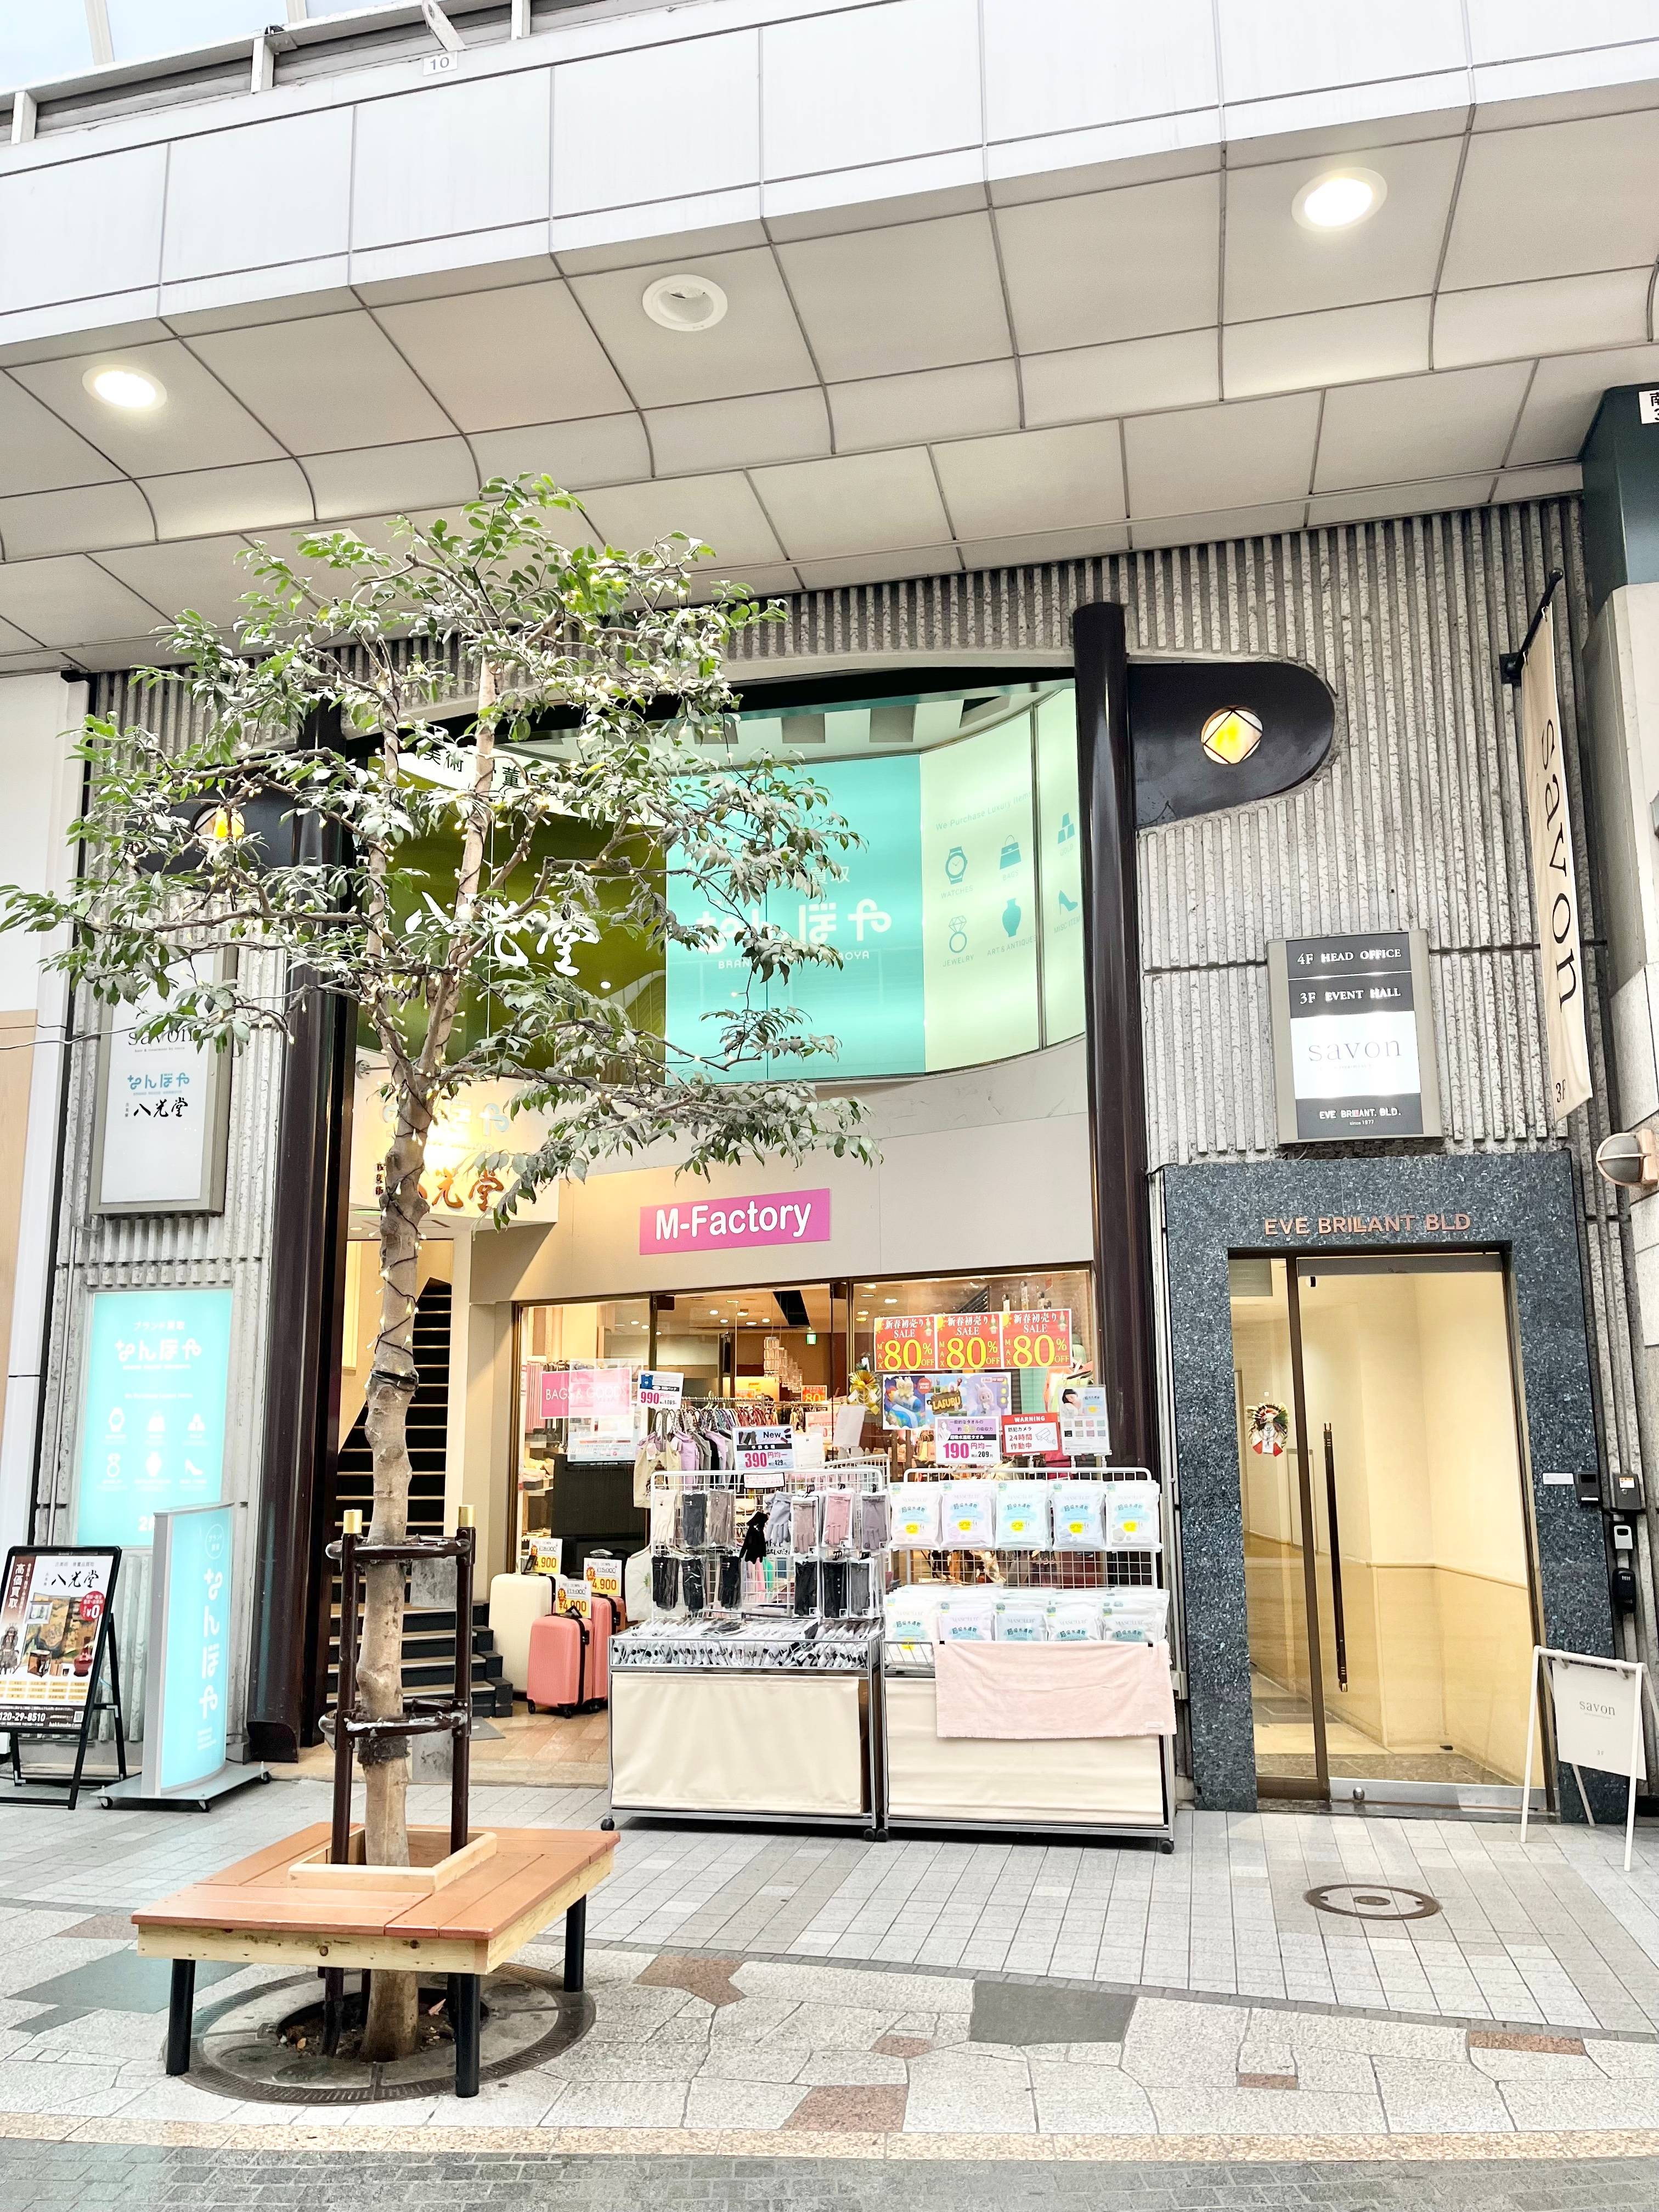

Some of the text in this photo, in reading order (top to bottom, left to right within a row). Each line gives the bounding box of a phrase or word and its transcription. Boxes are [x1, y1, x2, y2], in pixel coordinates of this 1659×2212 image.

[430, 57, 449, 70] 10
[935, 823, 949, 831] We
[950, 810, 986, 828] Purchase
[988, 800, 1012, 815] Luxury
[1542, 718, 1576, 1013] savon
[1002, 870, 1020, 882] BAGS
[940, 885, 974, 900] WATCHES
[988, 947, 1000, 957] ART
[1297, 949, 1402, 965] 4F HEAD OFFICE
[718, 958, 750, 969] BRAN
[942, 955, 974, 968] JEWELRY
[1300, 988, 1401, 1005] 3F EVENT HALL
[1308, 1040, 1402, 1062] savon
[127, 1073, 190, 1090] なんぼや
[1319, 1110, 1336, 1119] EVE
[656, 1200, 812, 1240] M-Factory
[1265, 1217, 1309, 1235] EVE
[1426, 1213, 1470, 1231] BLD
[884, 1318, 924, 1330] 新春初売り
[947, 1315, 988, 1327] 新春初売り
[1014, 1312, 1057, 1324] 新春初売り
[894, 1329, 915, 1339] SALE
[957, 1327, 979, 1335] SALE
[1023, 1324, 1047, 1333] SALE
[115, 1338, 202, 1362] なんぼや
[884, 1339, 922, 1370] 80
[946, 1337, 986, 1369] 80
[1013, 1335, 1055, 1367] 80
[641, 1391, 659, 1404] 990
[943, 1442, 969, 1458] 190
[744, 1452, 767, 1468] 390
[199, 1568, 223, 1719] なんぼや
[1579, 1701, 1615, 1716] savon
